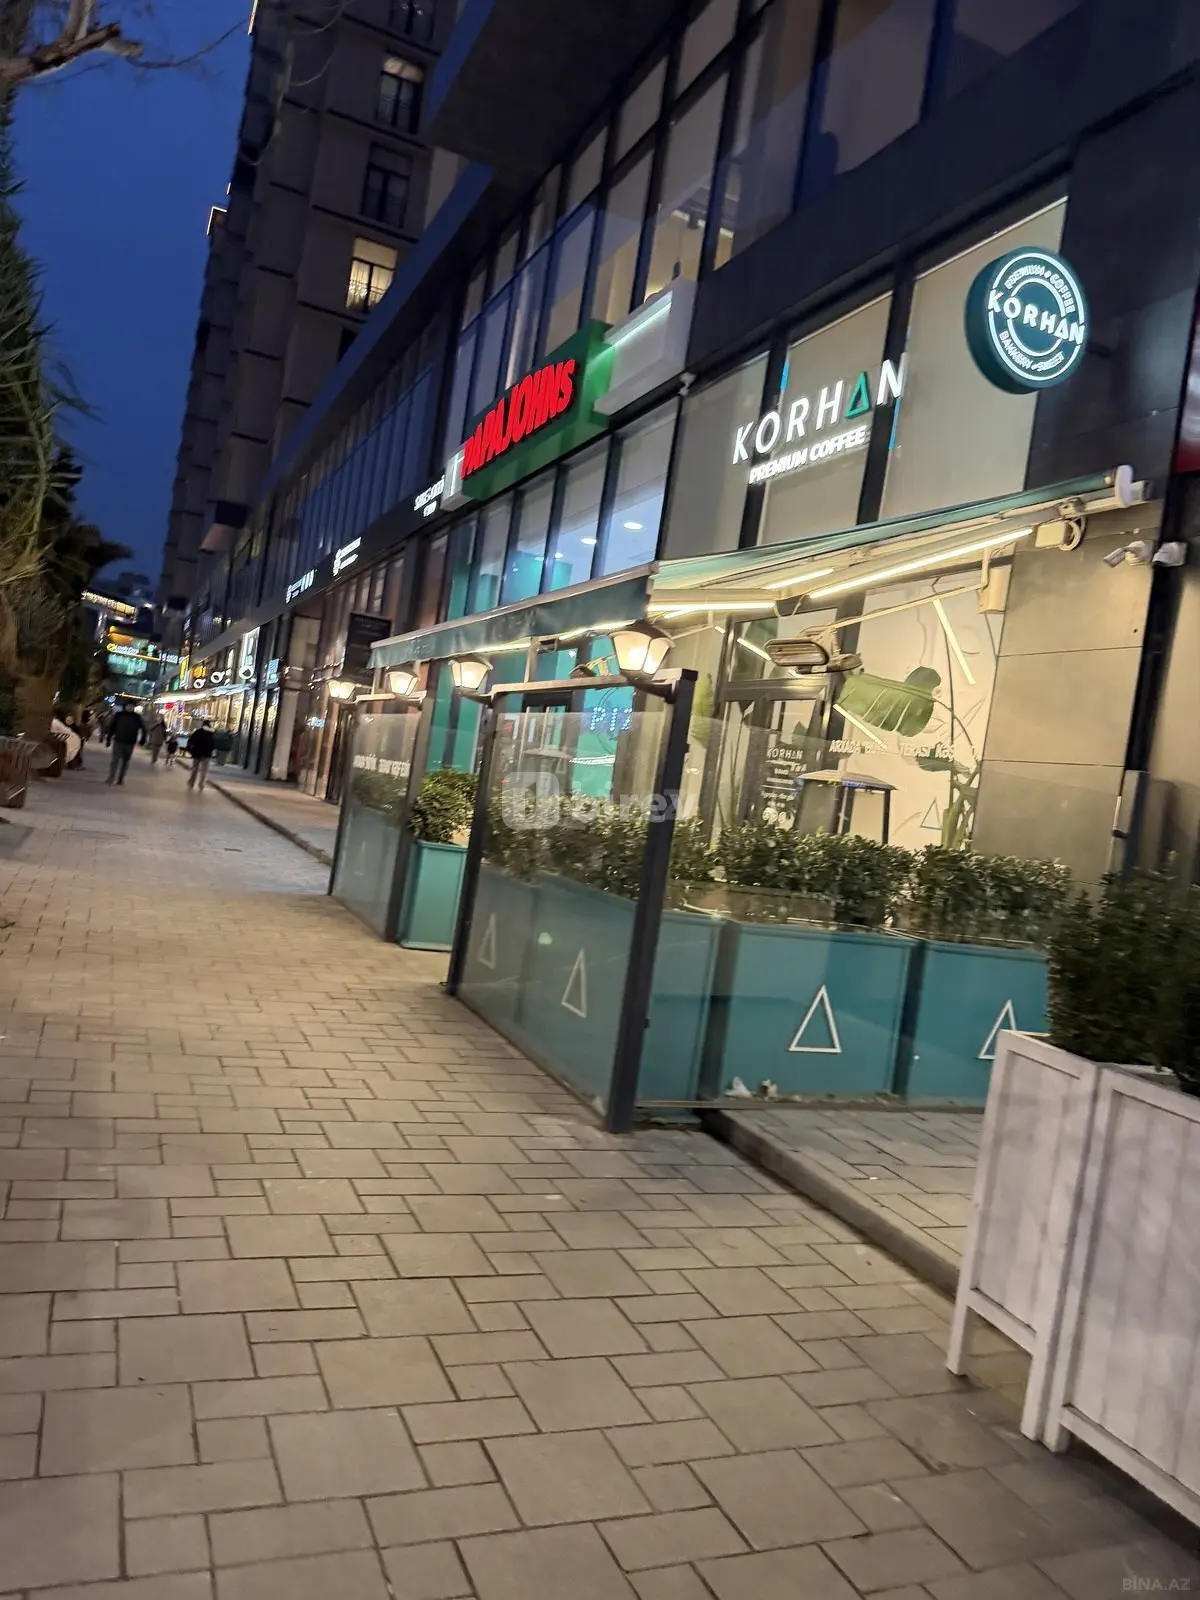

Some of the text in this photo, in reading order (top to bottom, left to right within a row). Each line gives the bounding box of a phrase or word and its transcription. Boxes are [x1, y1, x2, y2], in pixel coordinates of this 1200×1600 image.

[987, 288, 1086, 345] KORHAN
[1049, 273, 1076, 314] COFFEE
[732, 352, 909, 465] KORHAN
[748, 425, 871, 485] PREMIUM COFFEE
